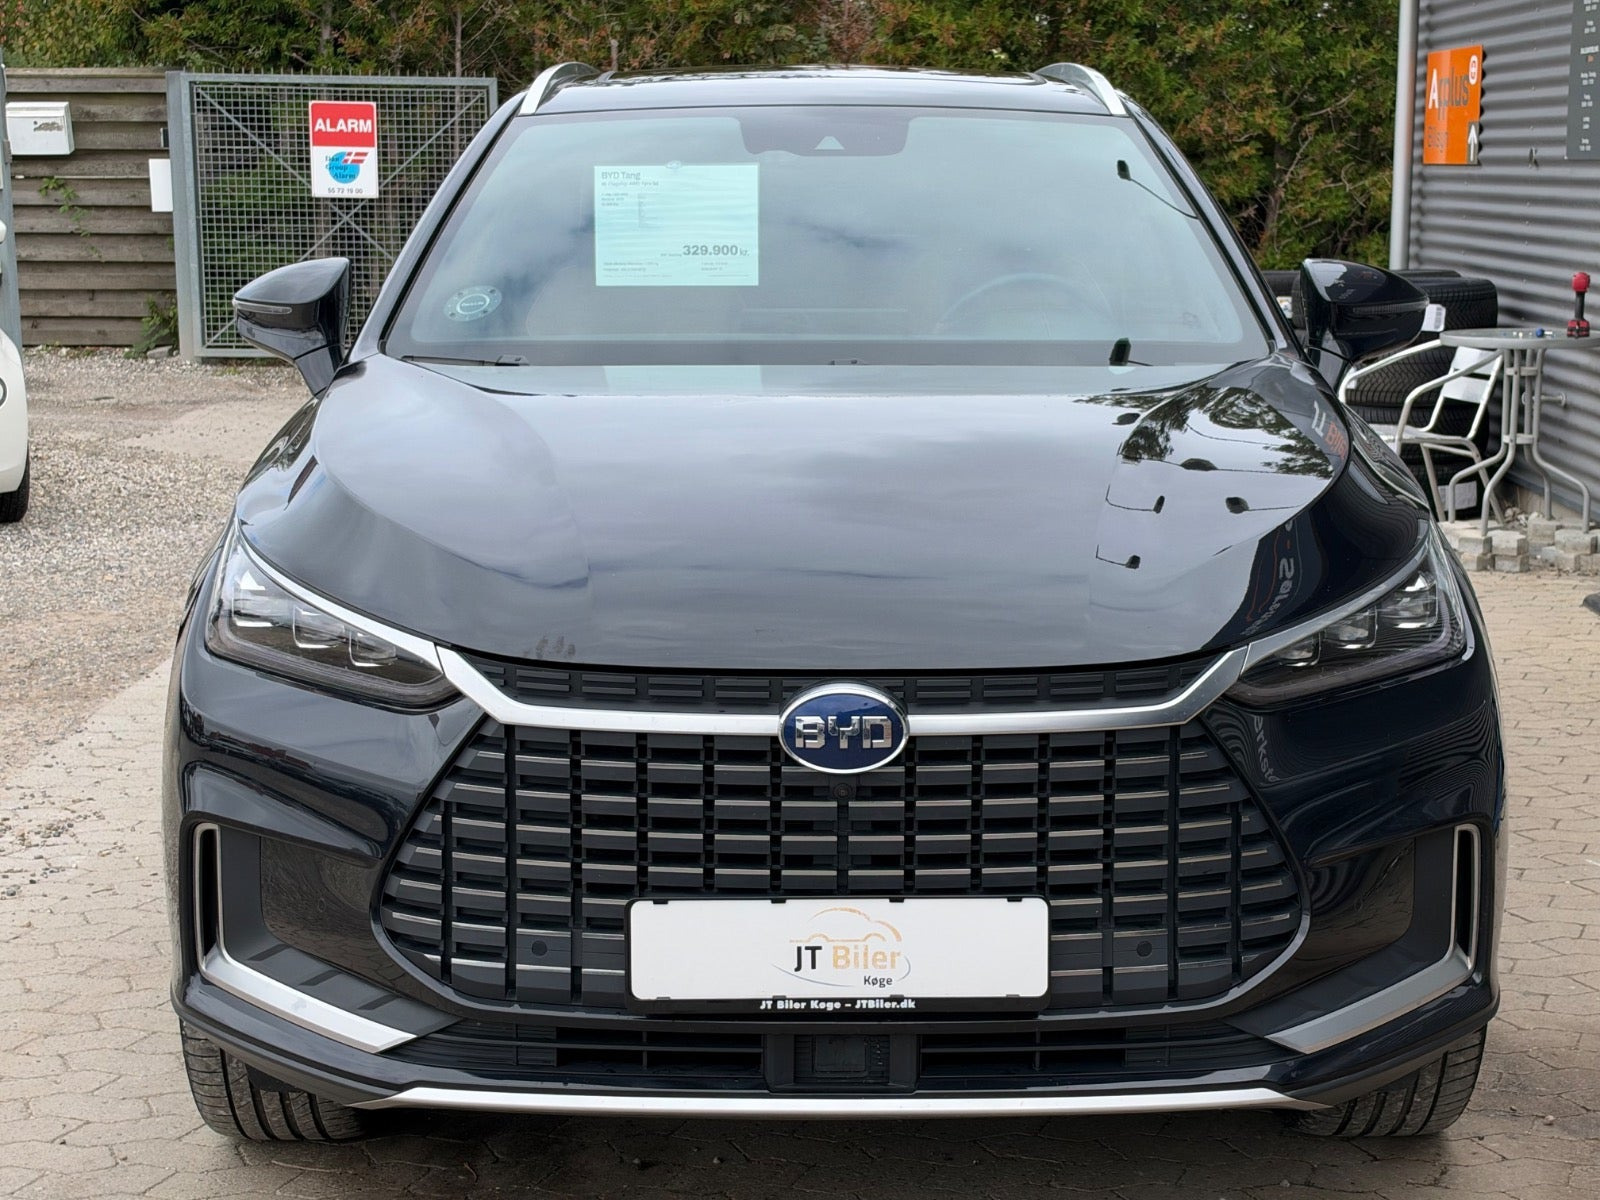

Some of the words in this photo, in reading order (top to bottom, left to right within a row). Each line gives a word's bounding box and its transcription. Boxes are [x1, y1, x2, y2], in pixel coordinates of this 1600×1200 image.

[314, 117, 373, 133] ALARM
[325, 163, 349, 173] Group
[333, 172, 357, 180] Alarm
[601, 171, 619, 179] BYD
[620, 171, 641, 180] Tang
[683, 245, 738, 256] 329.900
[795, 715, 892, 749] BYD
[794, 945, 822, 972] JT
[832, 944, 902, 970] Biler
[863, 975, 893, 988] Køge
[760, 999, 773, 1010] JT
[776, 999, 806, 1010] Biler
[855, 998, 916, 1010] JTBiler.dk
